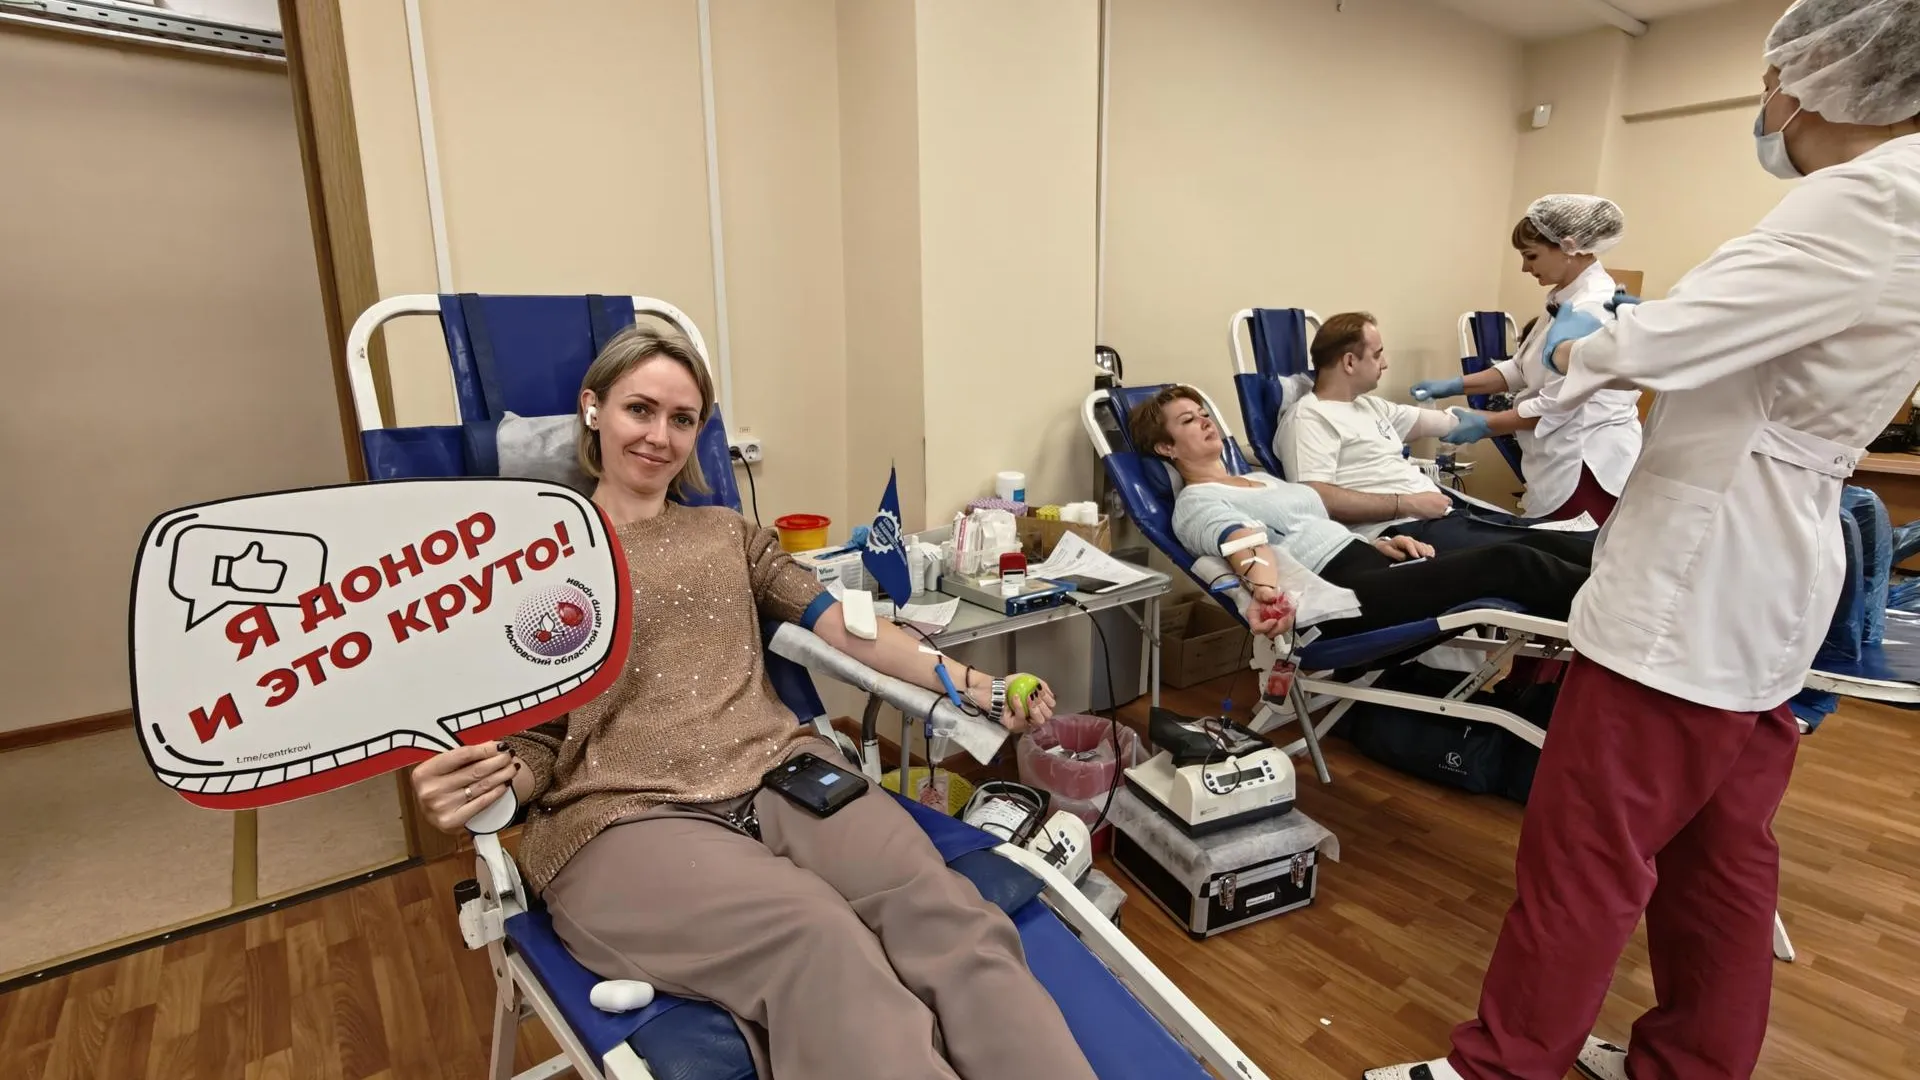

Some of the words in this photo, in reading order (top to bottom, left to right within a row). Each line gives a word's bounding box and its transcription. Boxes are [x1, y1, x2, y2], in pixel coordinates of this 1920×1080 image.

[225, 604, 280, 660] Я
[298, 511, 496, 634] донор
[566, 578, 594, 597] крови
[188, 693, 243, 743] и
[256, 631, 373, 708] это
[387, 520, 576, 644] круто!
[591, 599, 602, 628] центр
[505, 624, 552, 666] Московский
[554, 629, 599, 666] областной
